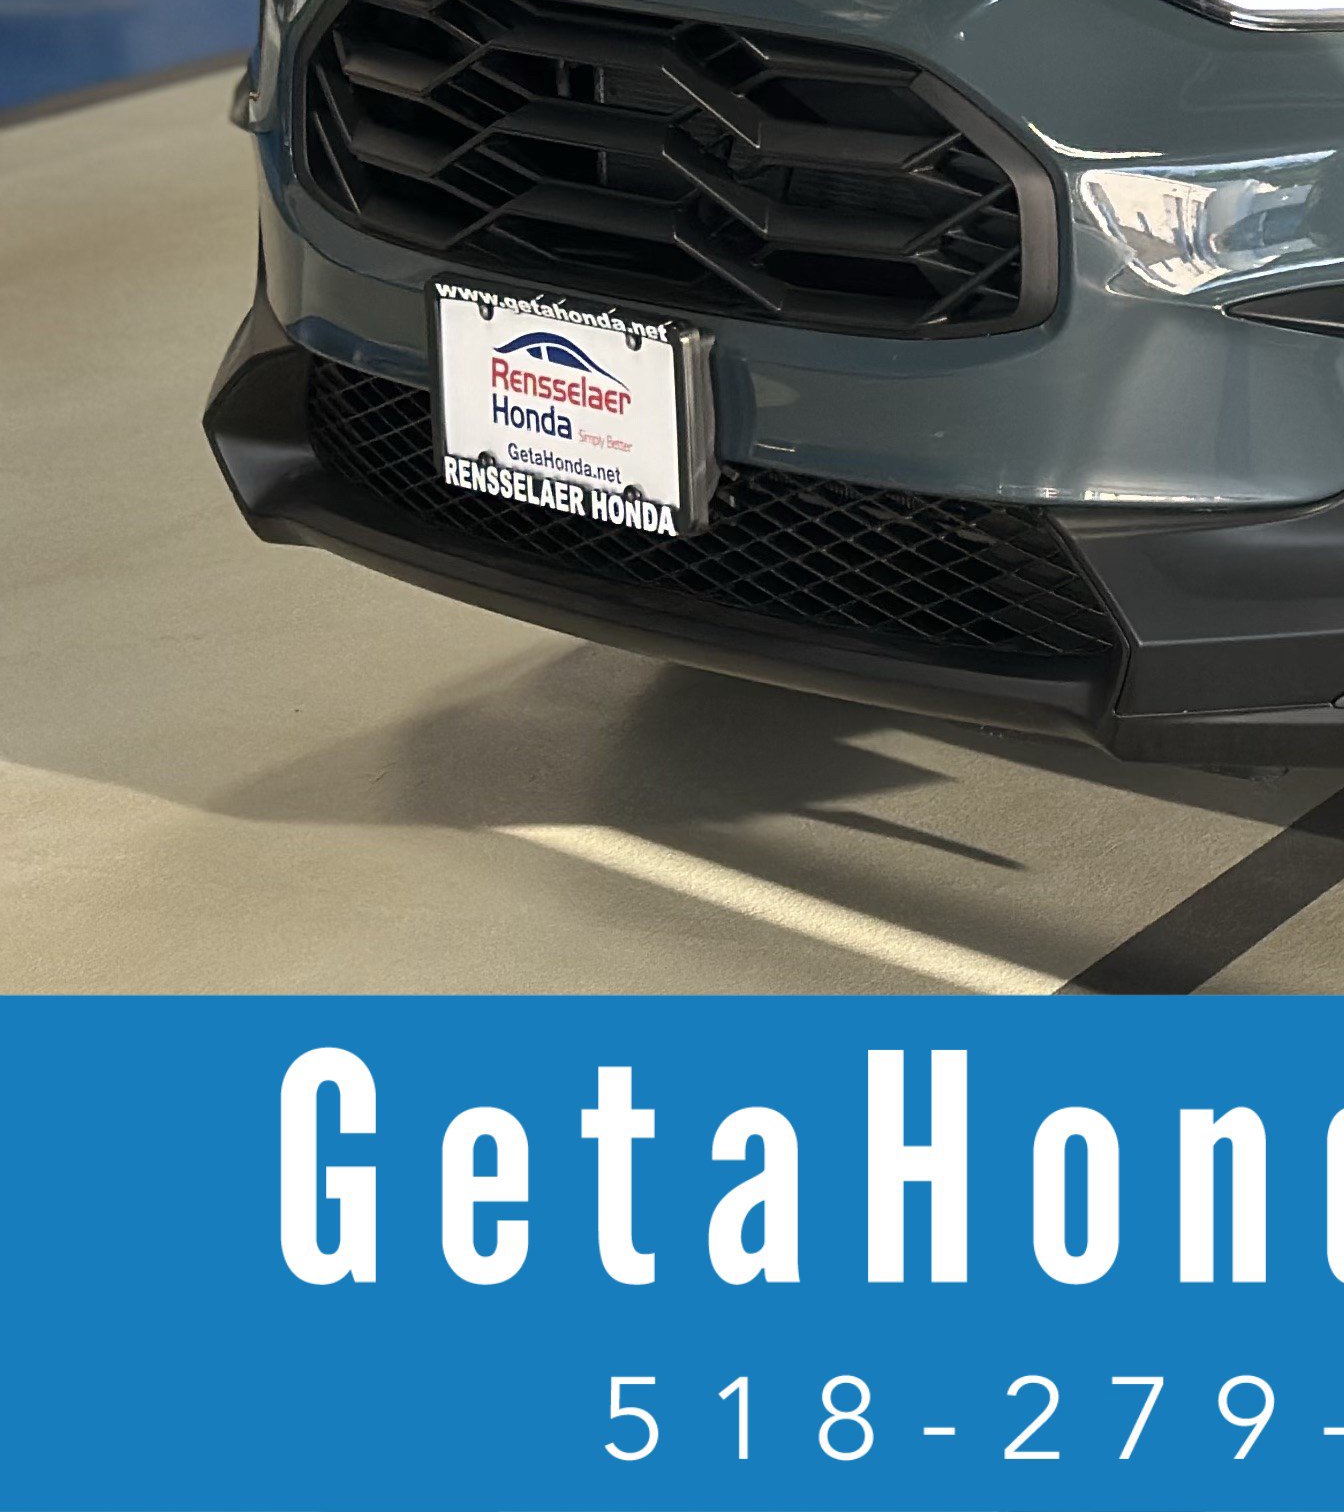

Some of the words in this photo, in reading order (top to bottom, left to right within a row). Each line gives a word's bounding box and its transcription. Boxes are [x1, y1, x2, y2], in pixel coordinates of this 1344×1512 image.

[435, 283, 668, 342] www.getahonda.net
[491, 356, 632, 415] Rensselaer
[492, 393, 573, 440] Honda
[507, 442, 622, 485] GetaHonda.net
[444, 456, 585, 516] RENSSELAER
[591, 490, 678, 537] HONDA
